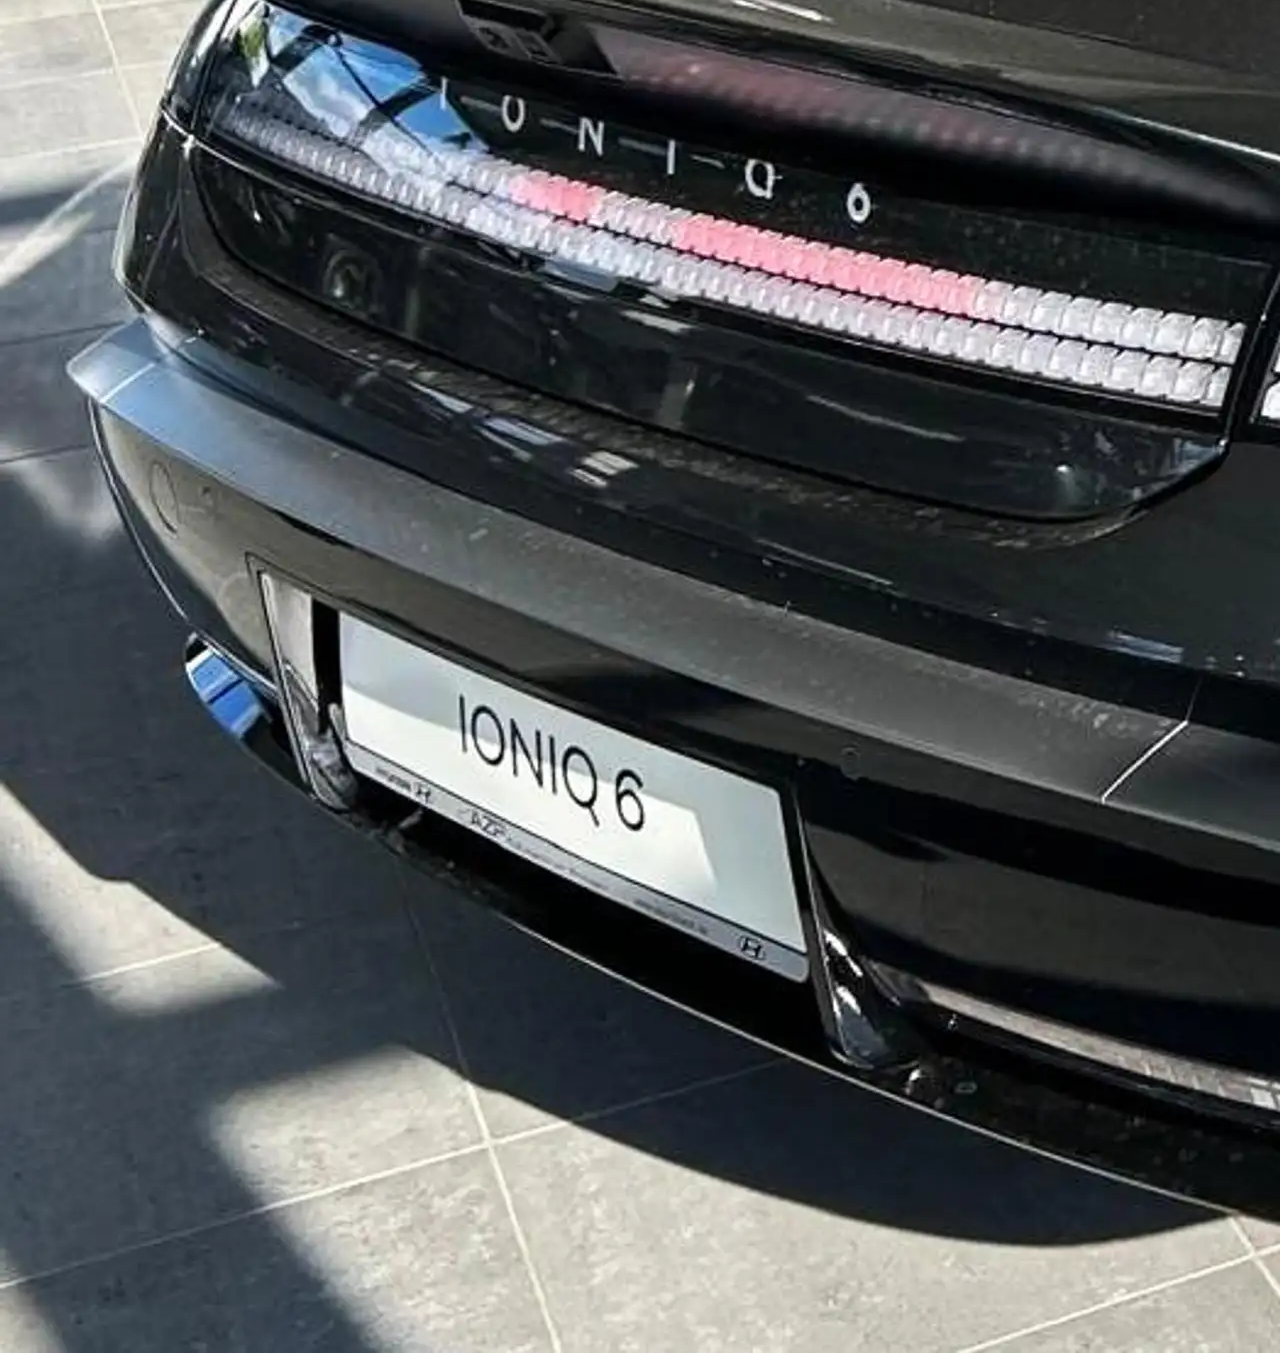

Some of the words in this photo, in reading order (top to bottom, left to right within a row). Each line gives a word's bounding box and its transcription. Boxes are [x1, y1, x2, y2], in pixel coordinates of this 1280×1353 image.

[440, 77, 782, 200] IONIQ
[845, 182, 873, 225] 6
[458, 694, 601, 828] IONIQ
[614, 768, 646, 831] 6
